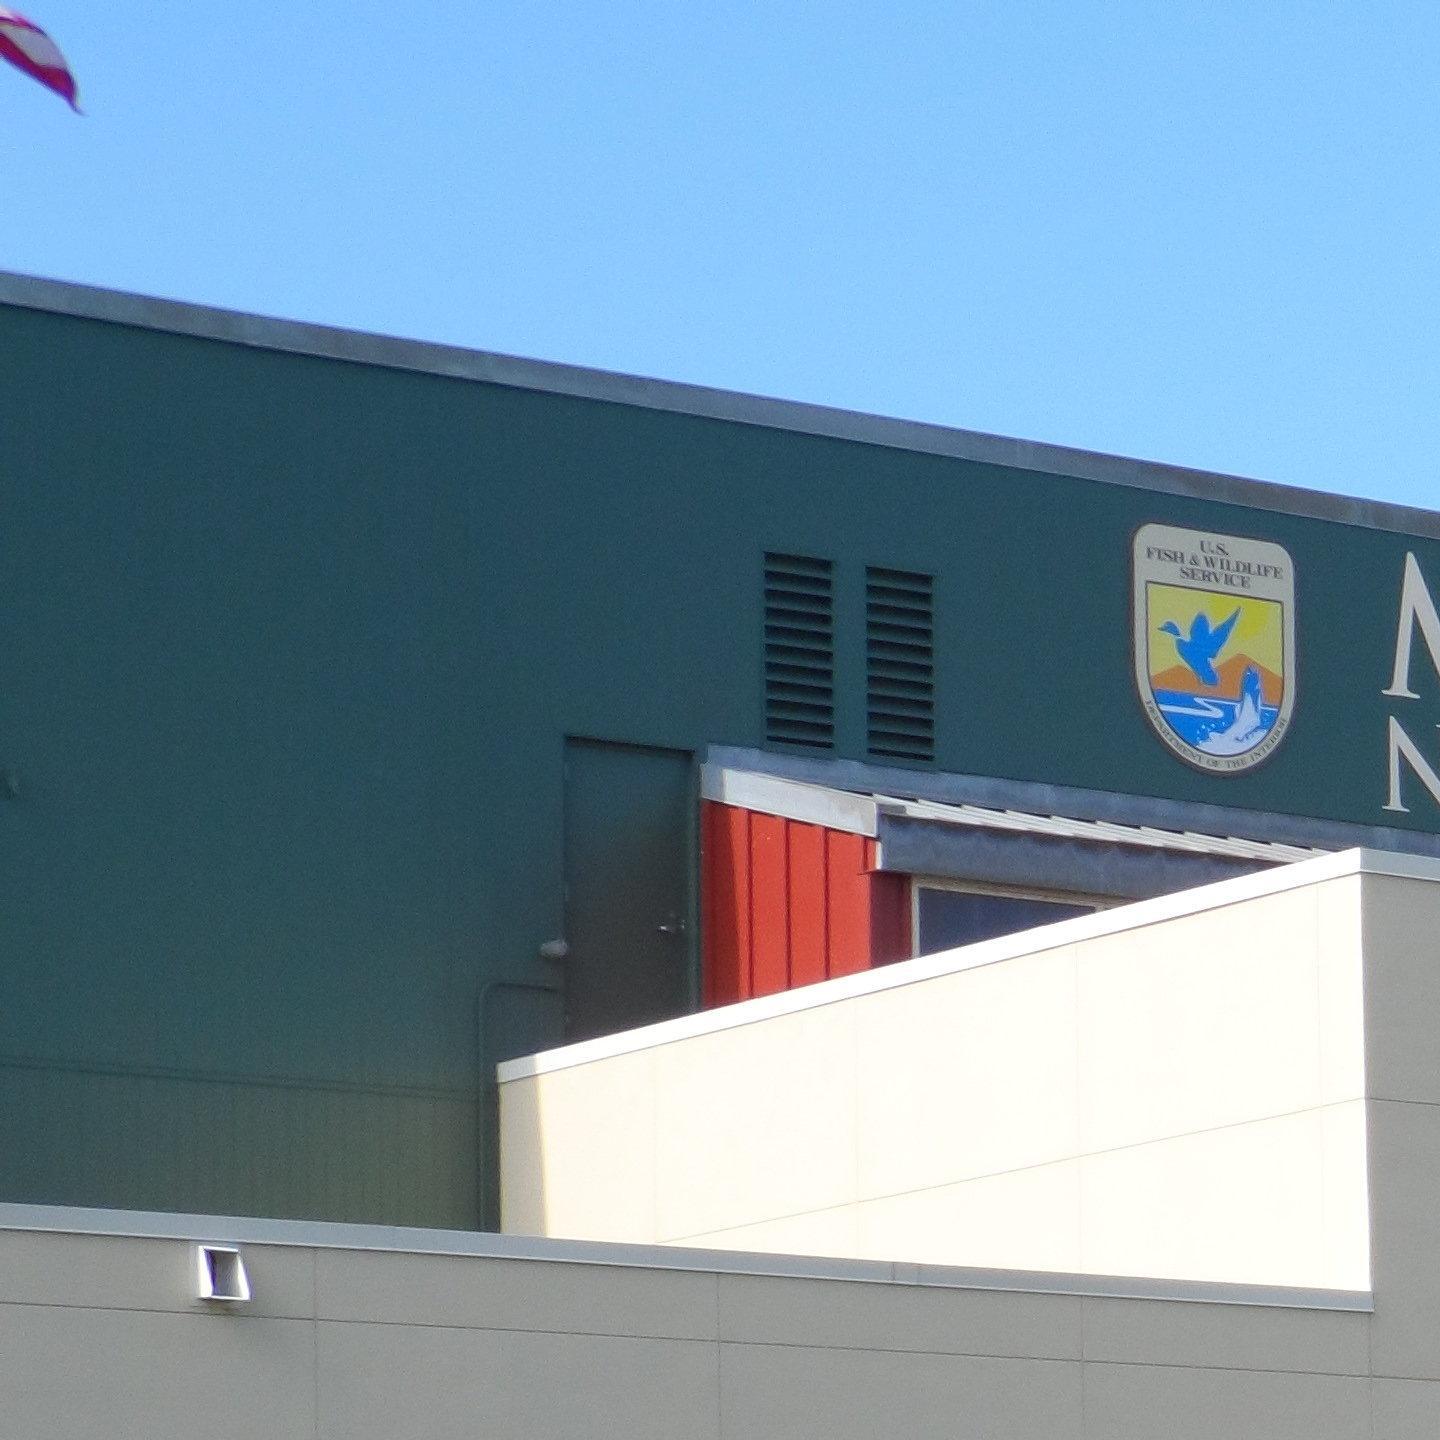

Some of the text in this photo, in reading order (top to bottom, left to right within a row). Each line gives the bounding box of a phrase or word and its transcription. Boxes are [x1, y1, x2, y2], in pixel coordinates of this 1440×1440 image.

[1199, 540, 1230, 557] U.S.
[1145, 546, 1283, 580] FISH & WILDLIFE
[1179, 567, 1252, 589] SERVICE
